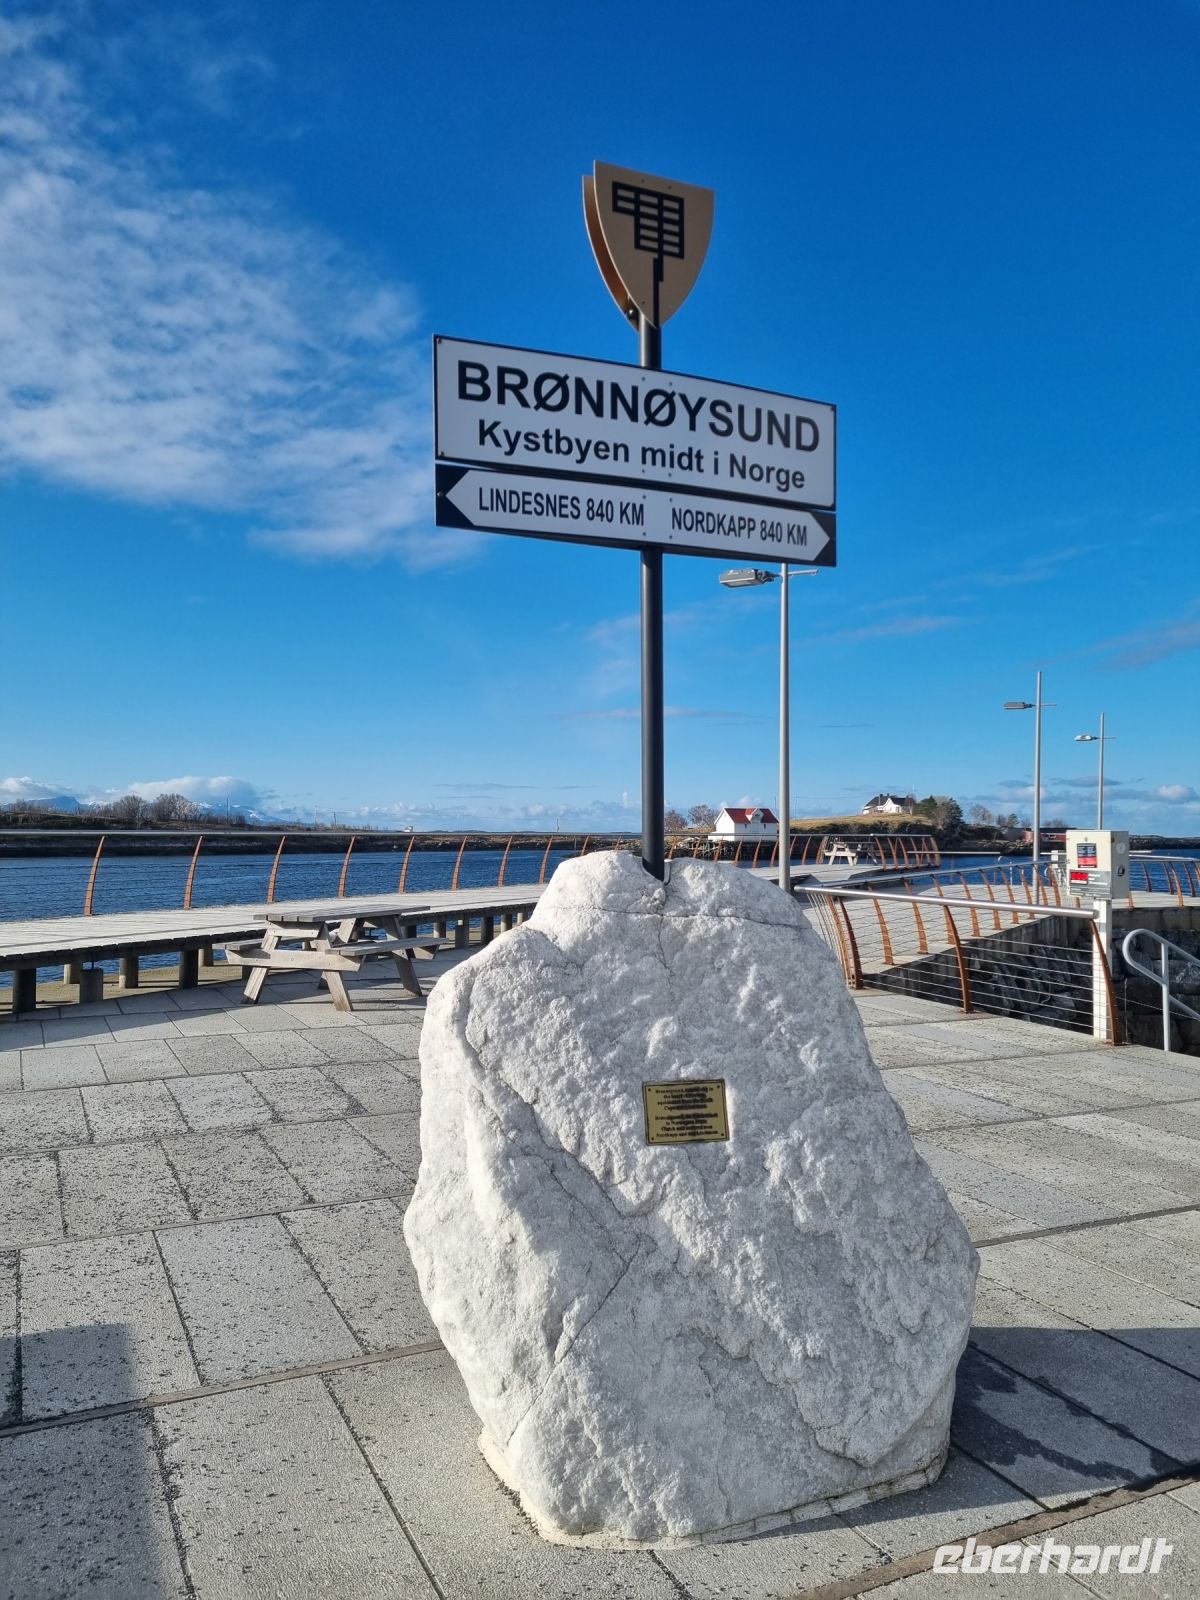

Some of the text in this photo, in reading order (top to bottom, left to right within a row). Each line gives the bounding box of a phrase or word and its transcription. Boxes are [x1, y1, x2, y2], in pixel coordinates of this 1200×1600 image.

[457, 359, 820, 452] BRØNNØYSUND
[478, 419, 805, 492] Kystbyen midt i Norge
[478, 487, 645, 527] LINDESNES 840 KM
[671, 508, 808, 546] NORDKAPP 840 KM
